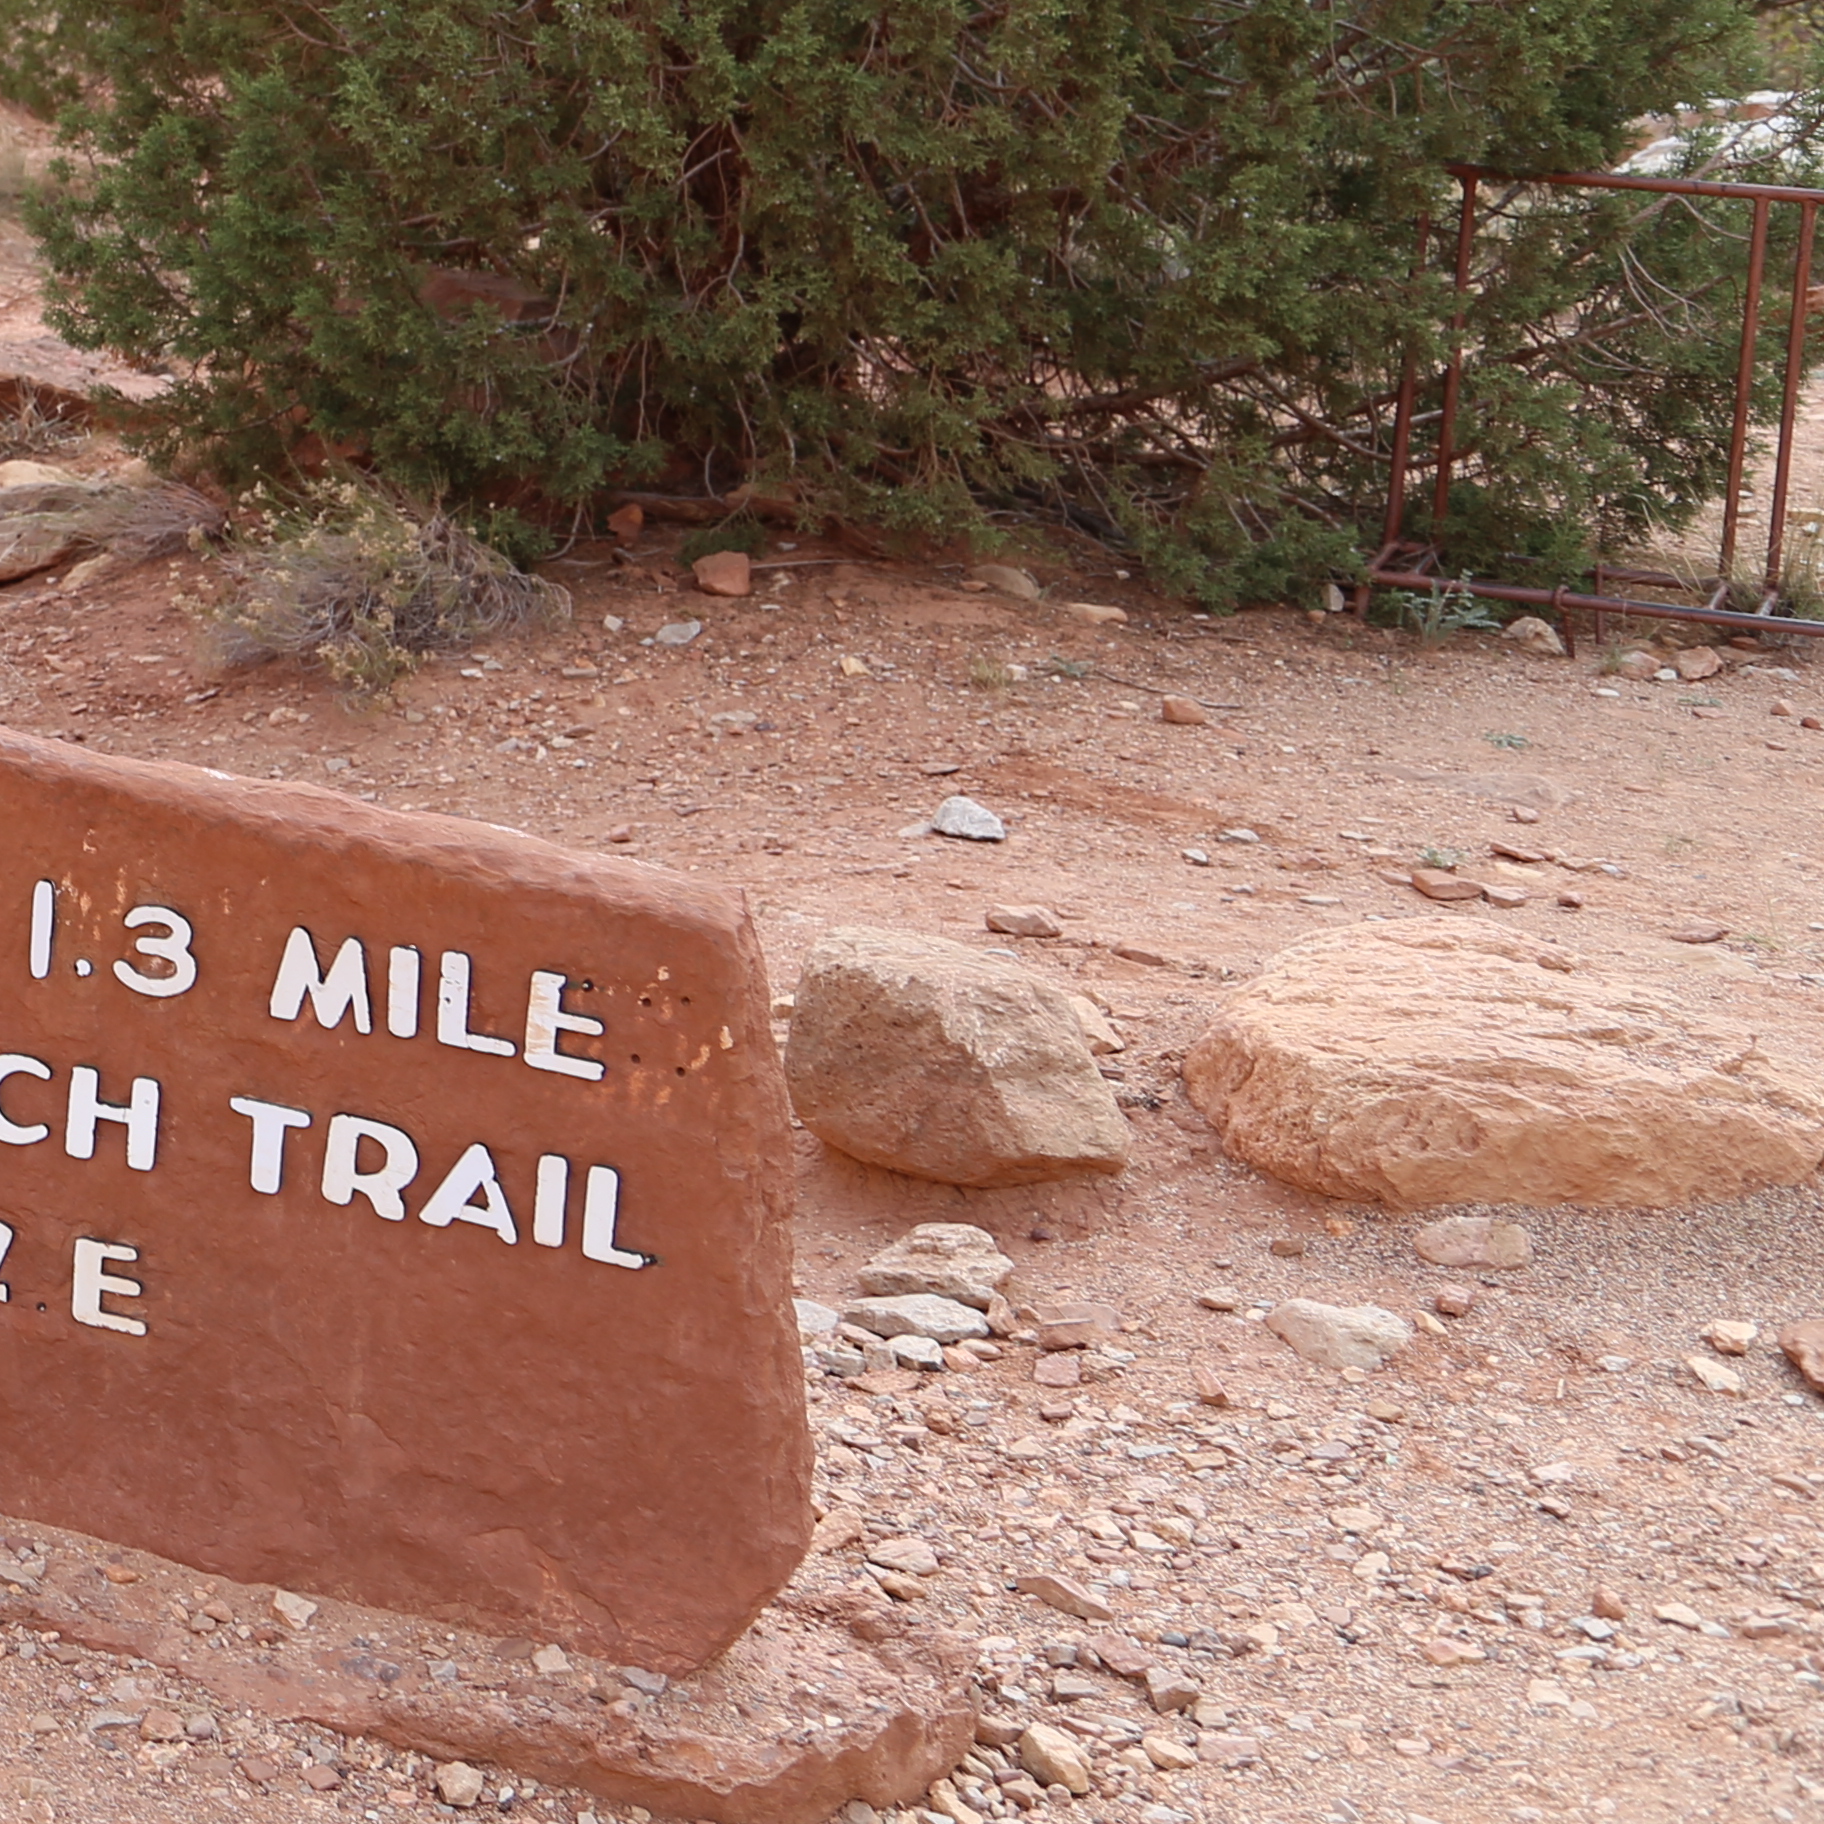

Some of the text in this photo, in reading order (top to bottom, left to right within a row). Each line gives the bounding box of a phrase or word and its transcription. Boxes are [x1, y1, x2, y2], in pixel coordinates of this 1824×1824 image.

[29, 878, 197, 998] 1.3
[269, 926, 606, 1083] MILE
[229, 1095, 647, 1271] TRAIL
